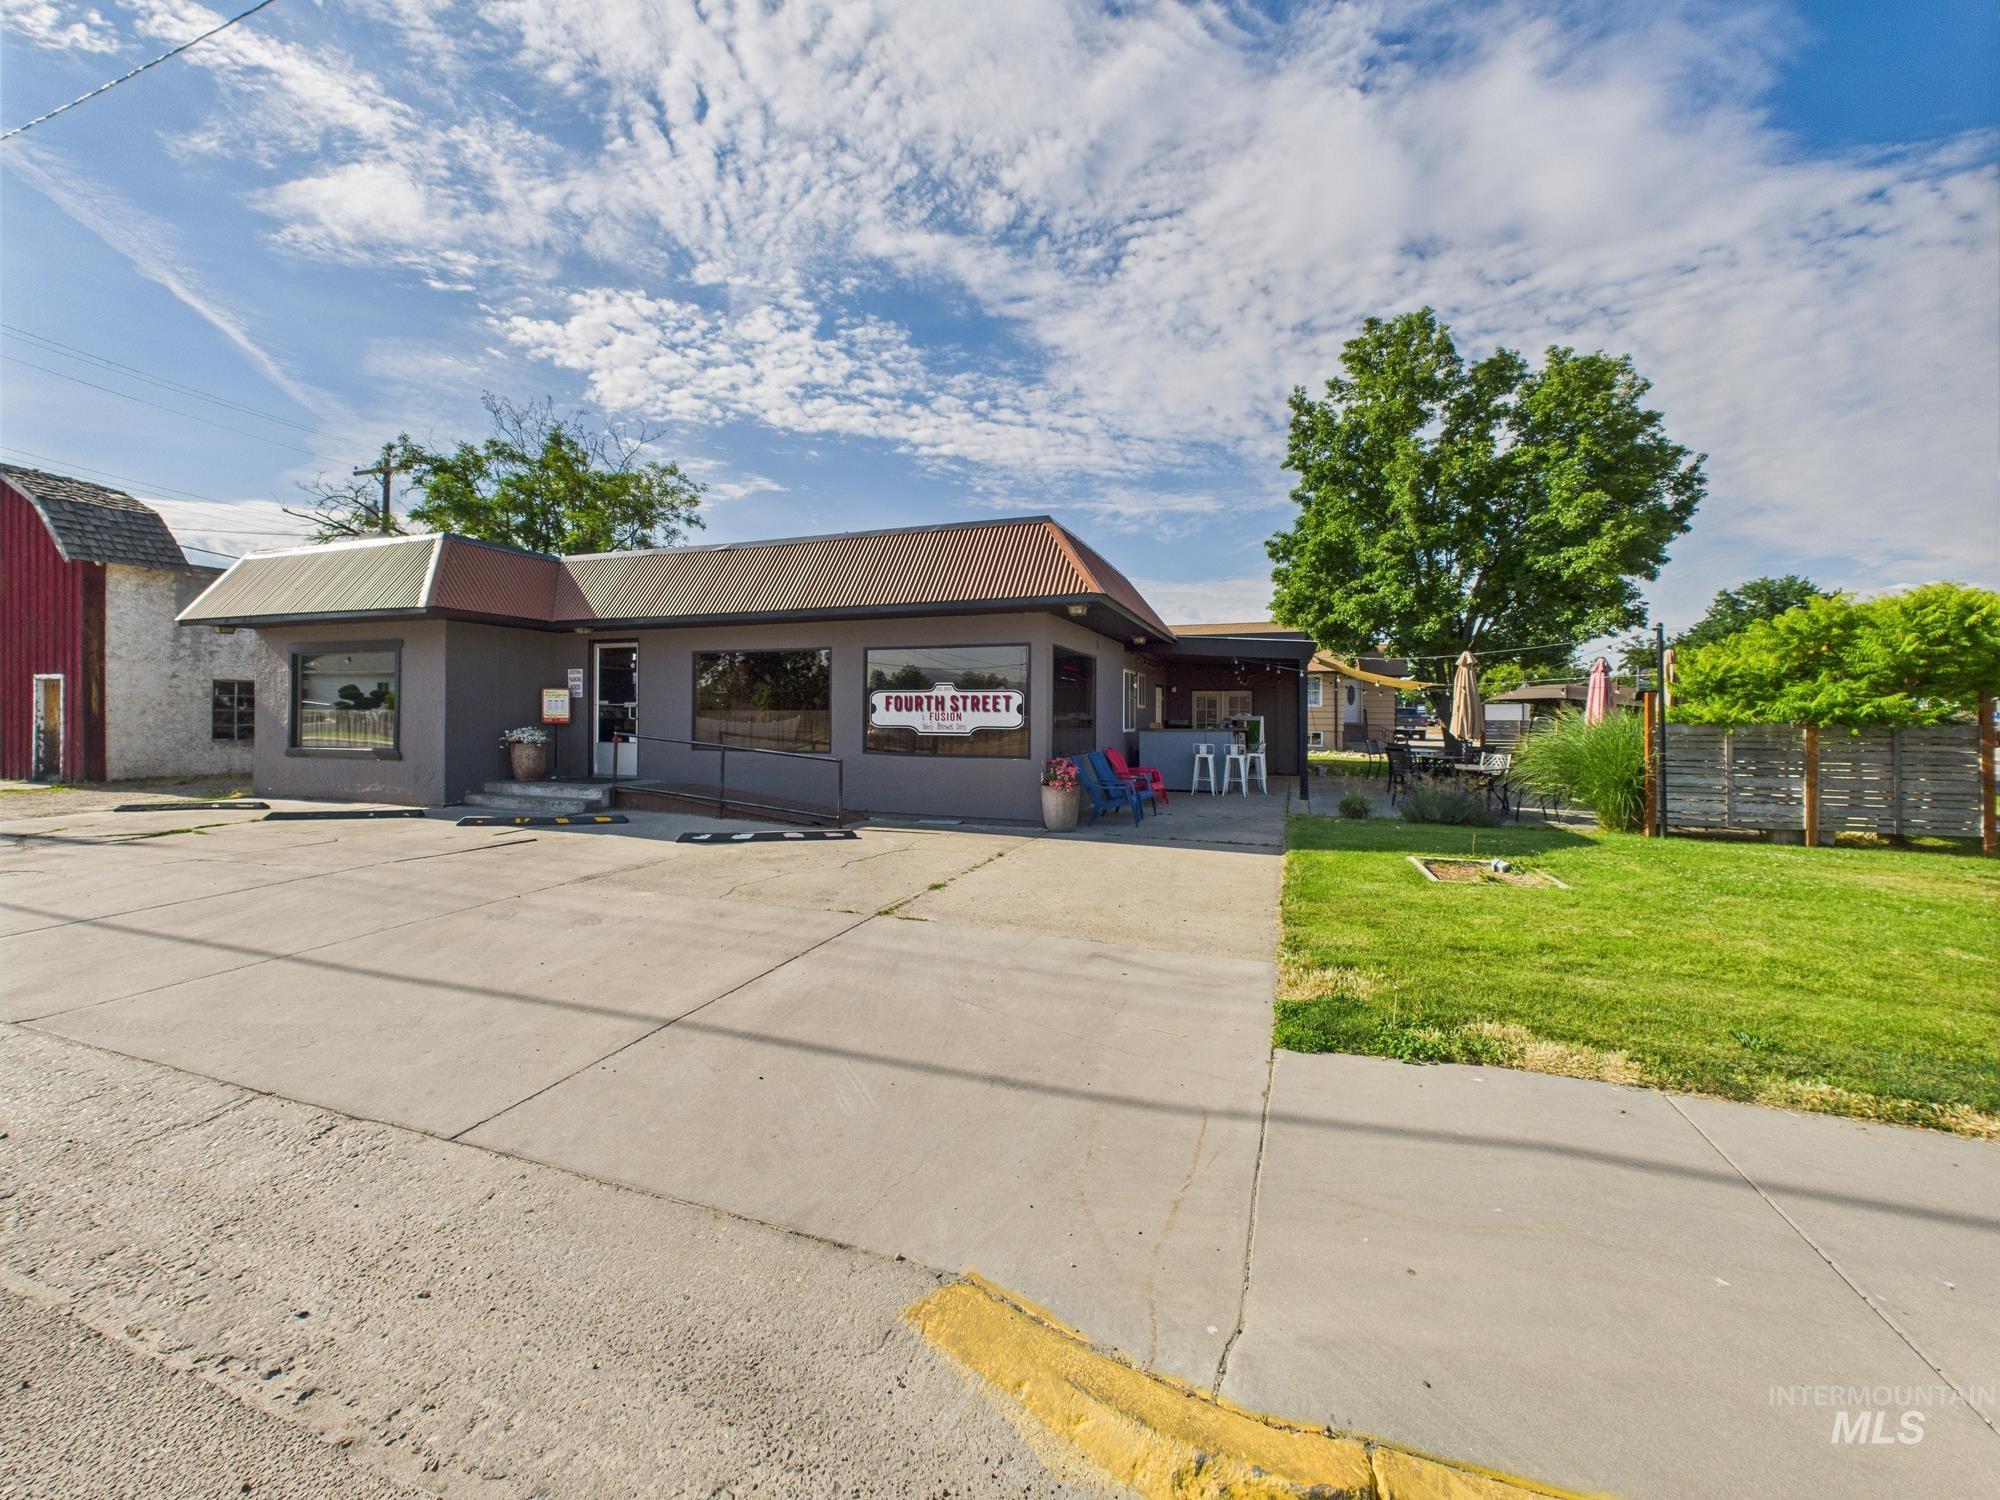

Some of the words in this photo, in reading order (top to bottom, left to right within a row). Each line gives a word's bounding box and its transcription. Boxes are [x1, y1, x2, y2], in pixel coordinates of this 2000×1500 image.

[884, 695, 945, 713] FOURTH
[950, 695, 1013, 713] STREET
[929, 712, 962, 722] FUSION
